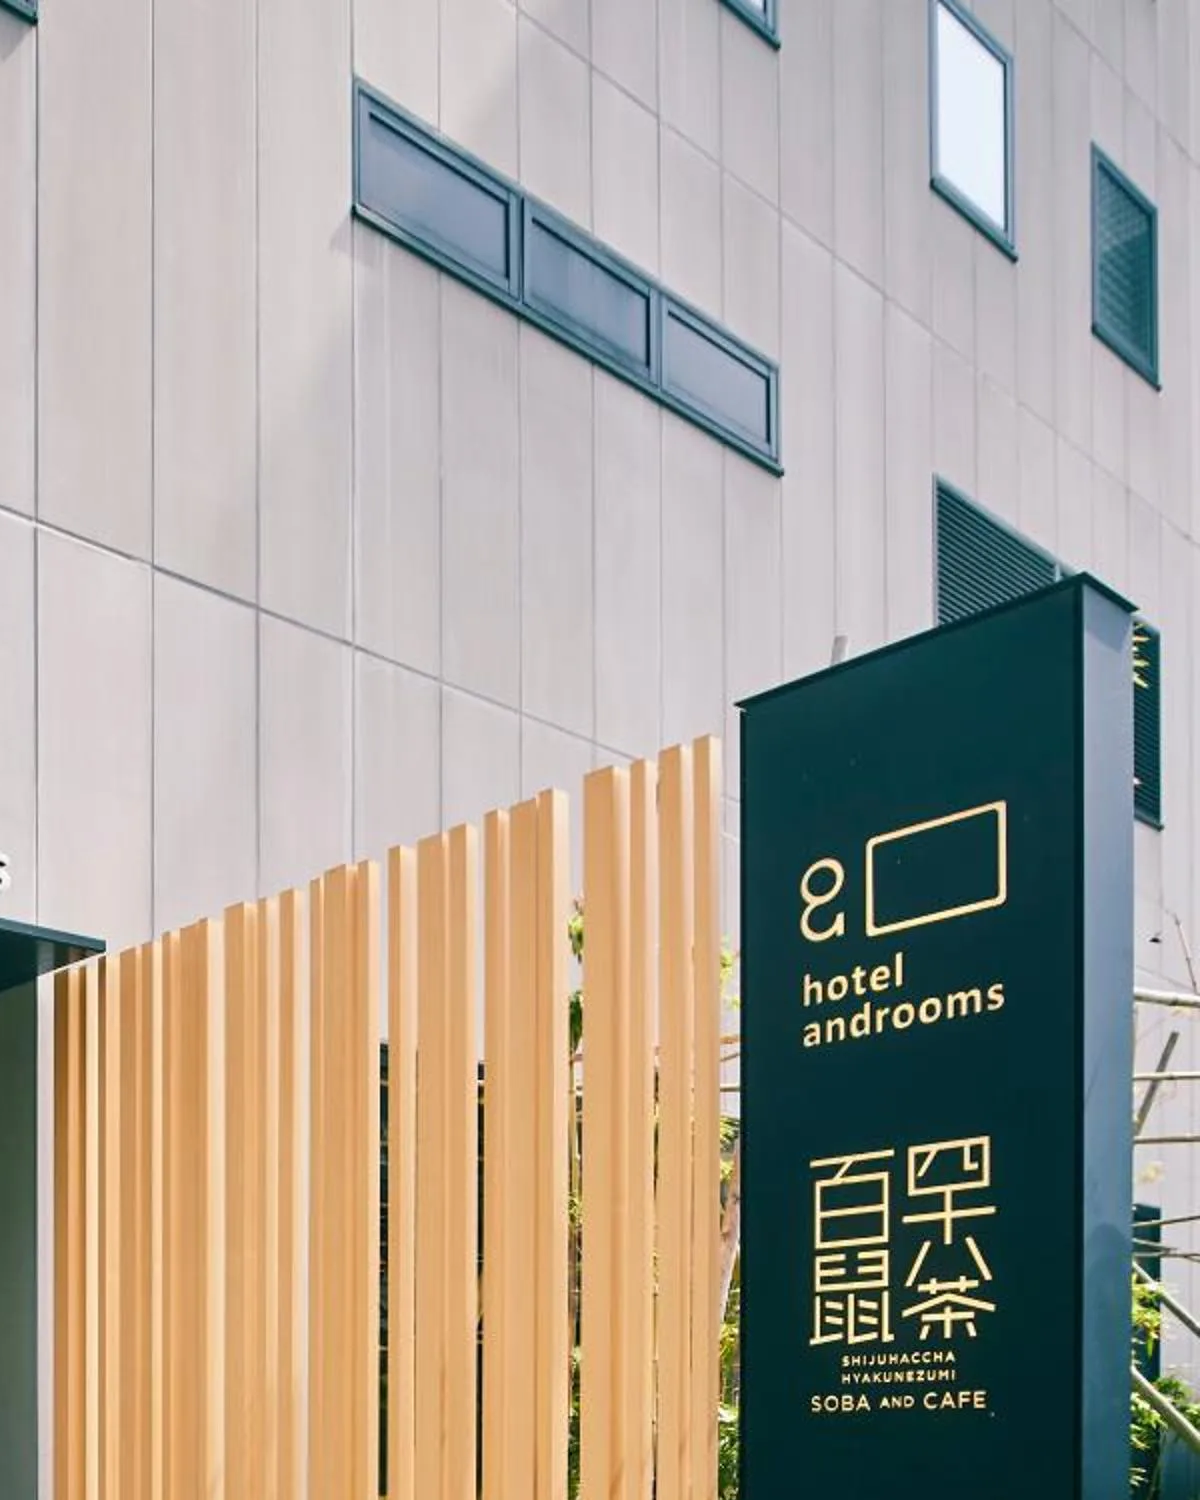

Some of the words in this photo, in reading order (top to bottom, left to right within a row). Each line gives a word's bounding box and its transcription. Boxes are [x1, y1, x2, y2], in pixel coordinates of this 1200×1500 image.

[803, 951, 903, 1007] hotel
[803, 983, 1005, 1048] androoms
[842, 1351, 956, 1367] SHIJUHACCHA
[841, 1369, 956, 1384] HYAKUNEZUMI
[811, 1393, 871, 1412] SOBA
[879, 1395, 915, 1409] AND
[923, 1390, 987, 1410] CAFE
